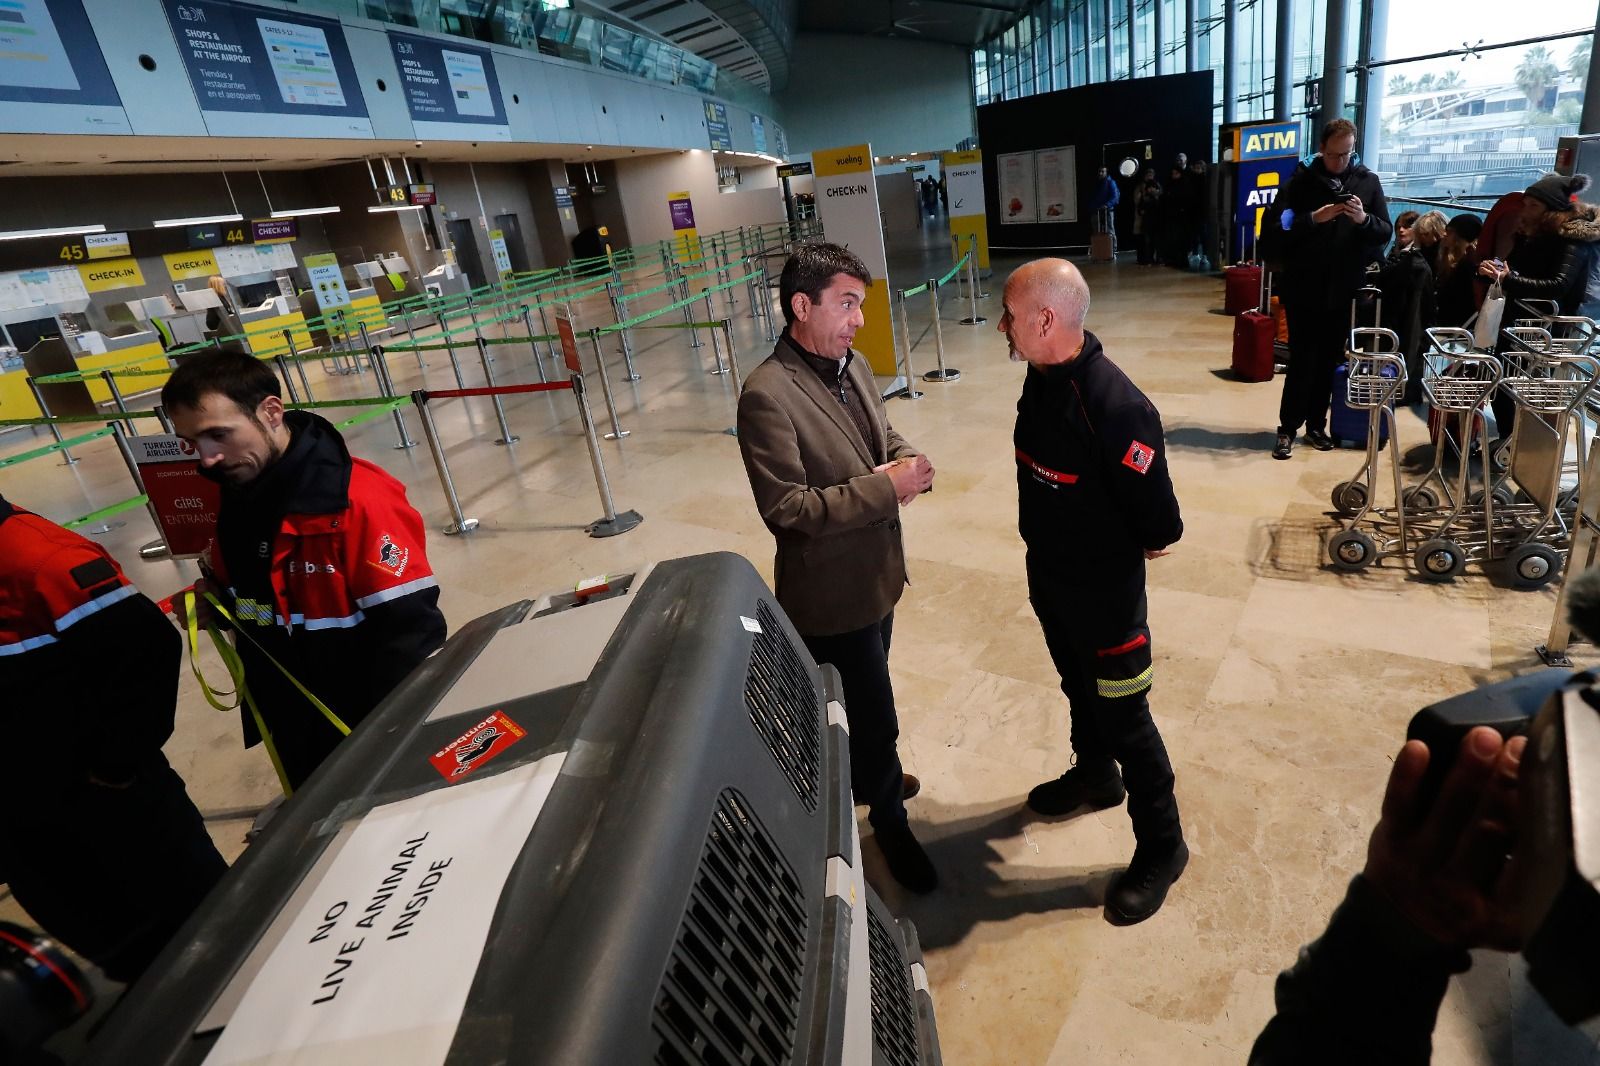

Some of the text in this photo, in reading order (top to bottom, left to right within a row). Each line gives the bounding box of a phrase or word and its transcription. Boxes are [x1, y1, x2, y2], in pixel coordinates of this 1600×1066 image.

[185, 29, 220, 41] SHOPS &
[189, 40, 243, 53] RESTAURANTS
[193, 50, 252, 64] AT THE AIRPORT
[200, 68, 233, 80] Tiendas y
[204, 81, 246, 90] restaurantes
[226, 92, 261, 101] aeropuerto
[1245, 130, 1296, 153] ATM
[836, 154, 862, 166] vueling
[391, 188, 405, 201] 43
[826, 185, 867, 197] CHECK-IN
[226, 229, 244, 242] 44
[258, 226, 290, 235] CHECK-IN
[59, 245, 84, 261] 45
[173, 259, 212, 271] CHECK-IN
[88, 268, 135, 281] CHECK-IN
[143, 441, 178, 450] TURKISH
[146, 448, 181, 457] AIRLINES
[174, 496, 204, 509] GİRİŞ
[165, 513, 217, 524] ENTRANC
[435, 715, 498, 758] Bombers
[386, 857, 453, 941] INSIDE
[308, 901, 348, 944] NO
[311, 831, 429, 1005] LIVE ANIMAL
